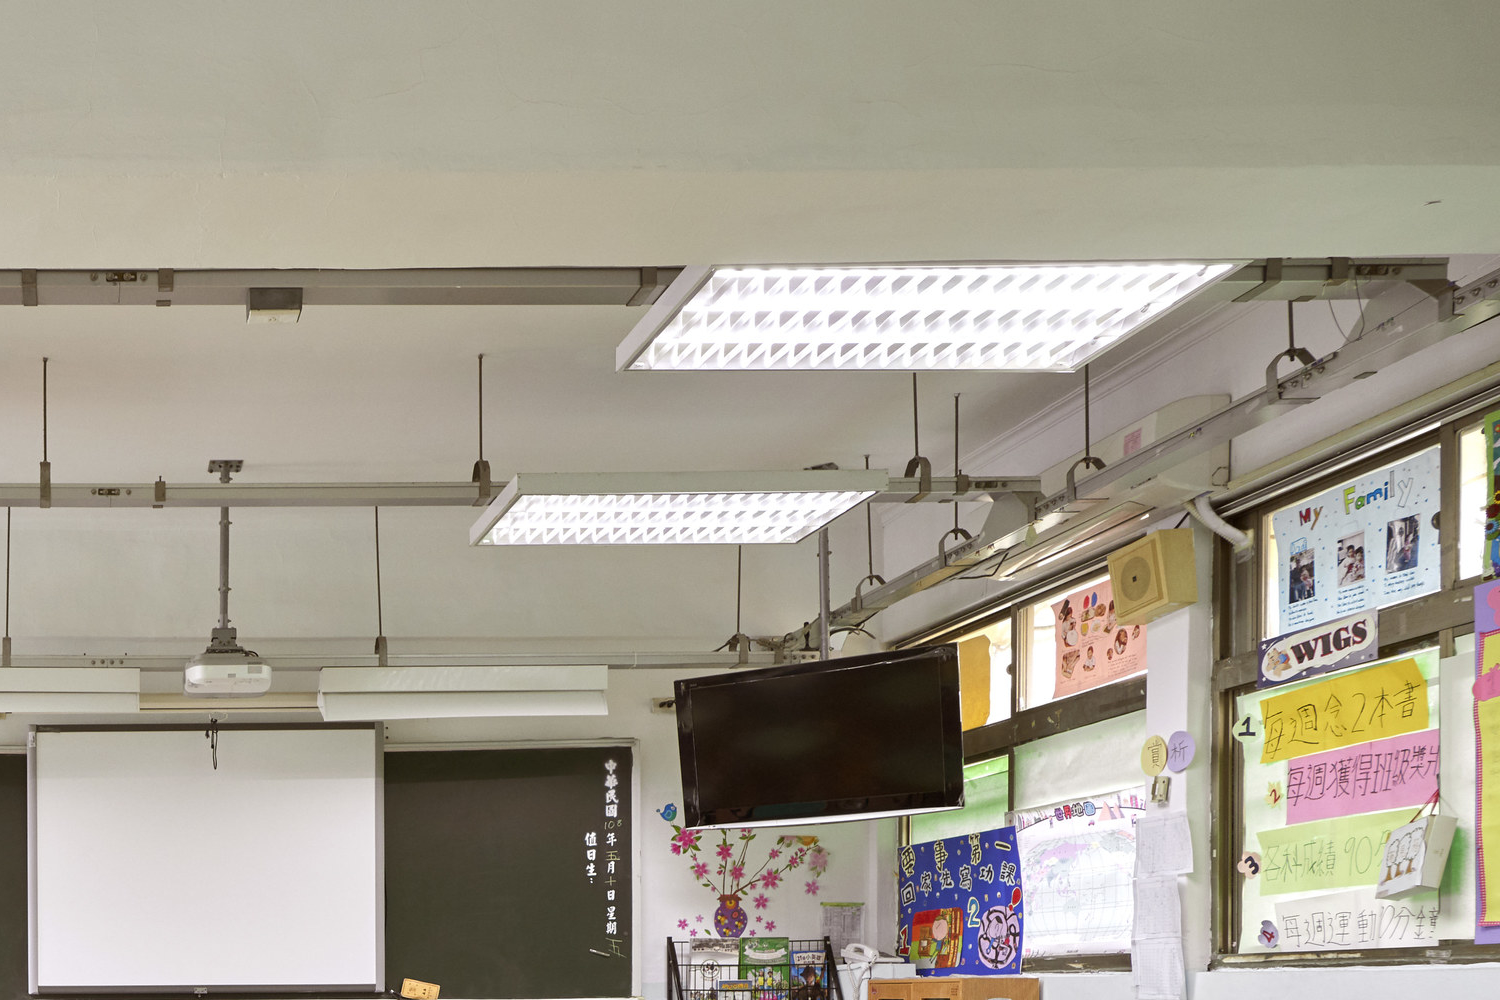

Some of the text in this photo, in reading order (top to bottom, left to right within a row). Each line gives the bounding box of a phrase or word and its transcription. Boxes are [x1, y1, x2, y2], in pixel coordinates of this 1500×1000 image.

[1299, 470, 1413, 531] My Family
[1291, 619, 1368, 664] WIGS
[1238, 716, 1256, 737] 1
[1263, 680, 1421, 760] 每週念2本書
[1170, 740, 1189, 762] 析
[1054, 801, 1096, 822] 世界地圖
[1269, 788, 1281, 804] 2
[901, 832, 1012, 877] 要事第一
[1244, 855, 1260, 875] 3
[1263, 840, 1336, 883] 各科成績
[901, 860, 1018, 906] 回家先寫功課
[967, 896, 981, 928] 2
[900, 924, 911, 957] 1
[1262, 931, 1275, 943] 4
